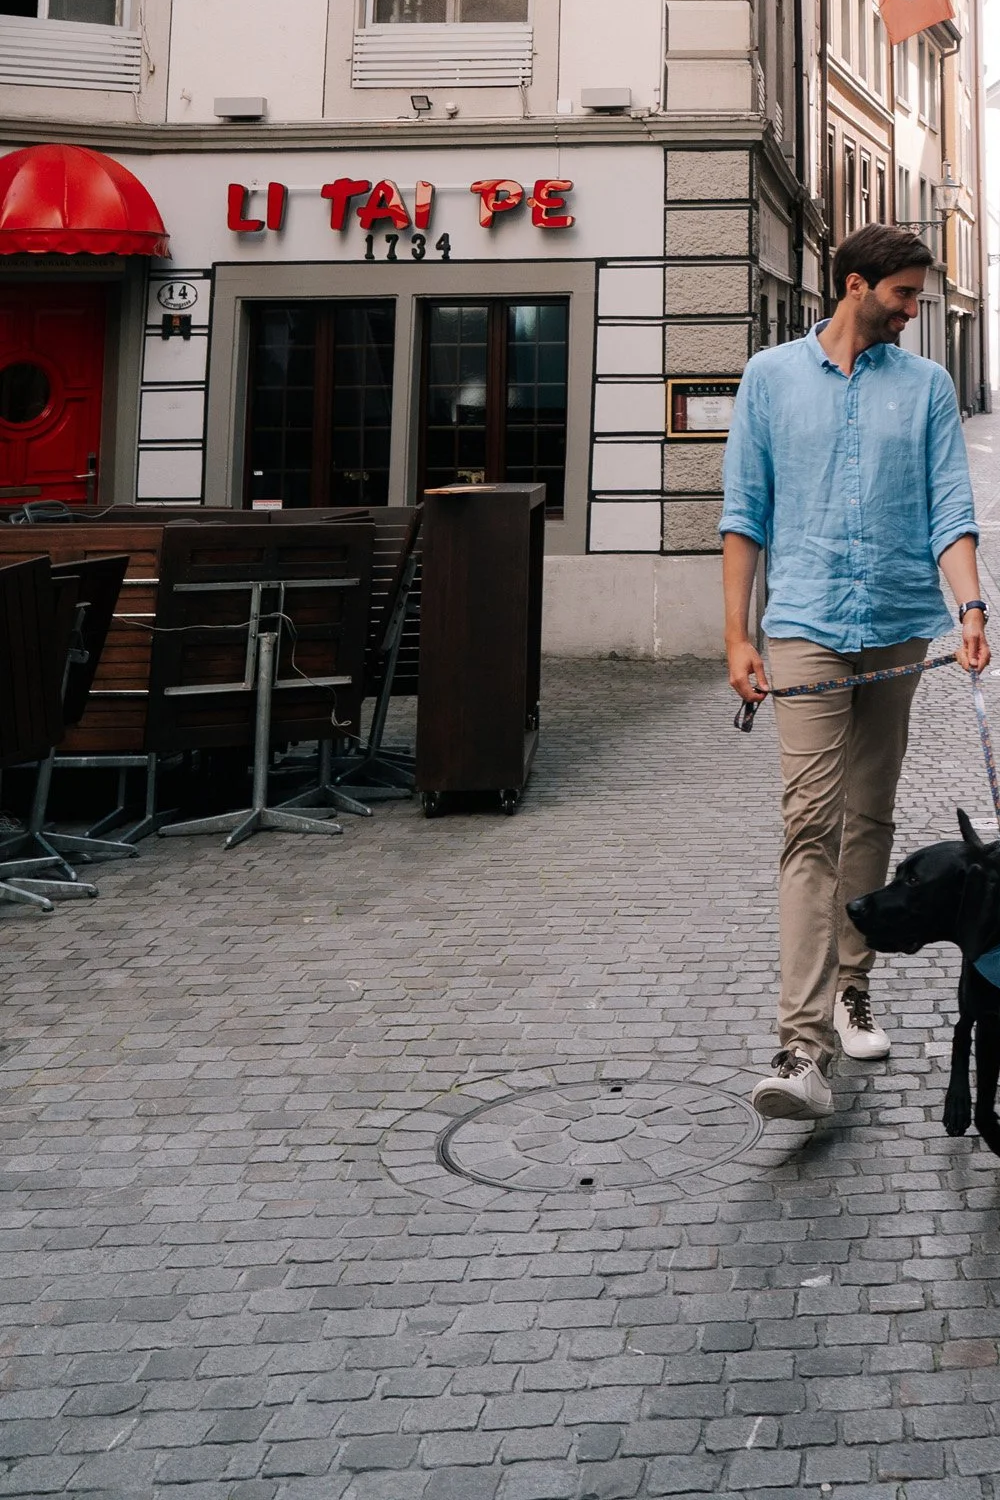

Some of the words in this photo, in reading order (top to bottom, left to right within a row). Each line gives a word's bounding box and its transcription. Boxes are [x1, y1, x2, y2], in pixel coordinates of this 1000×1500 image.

[228, 180, 289, 232] LI
[320, 178, 435, 232] TAI
[470, 179, 575, 229] PE
[364, 233, 451, 260] 1734
[168, 285, 188, 299] 14
